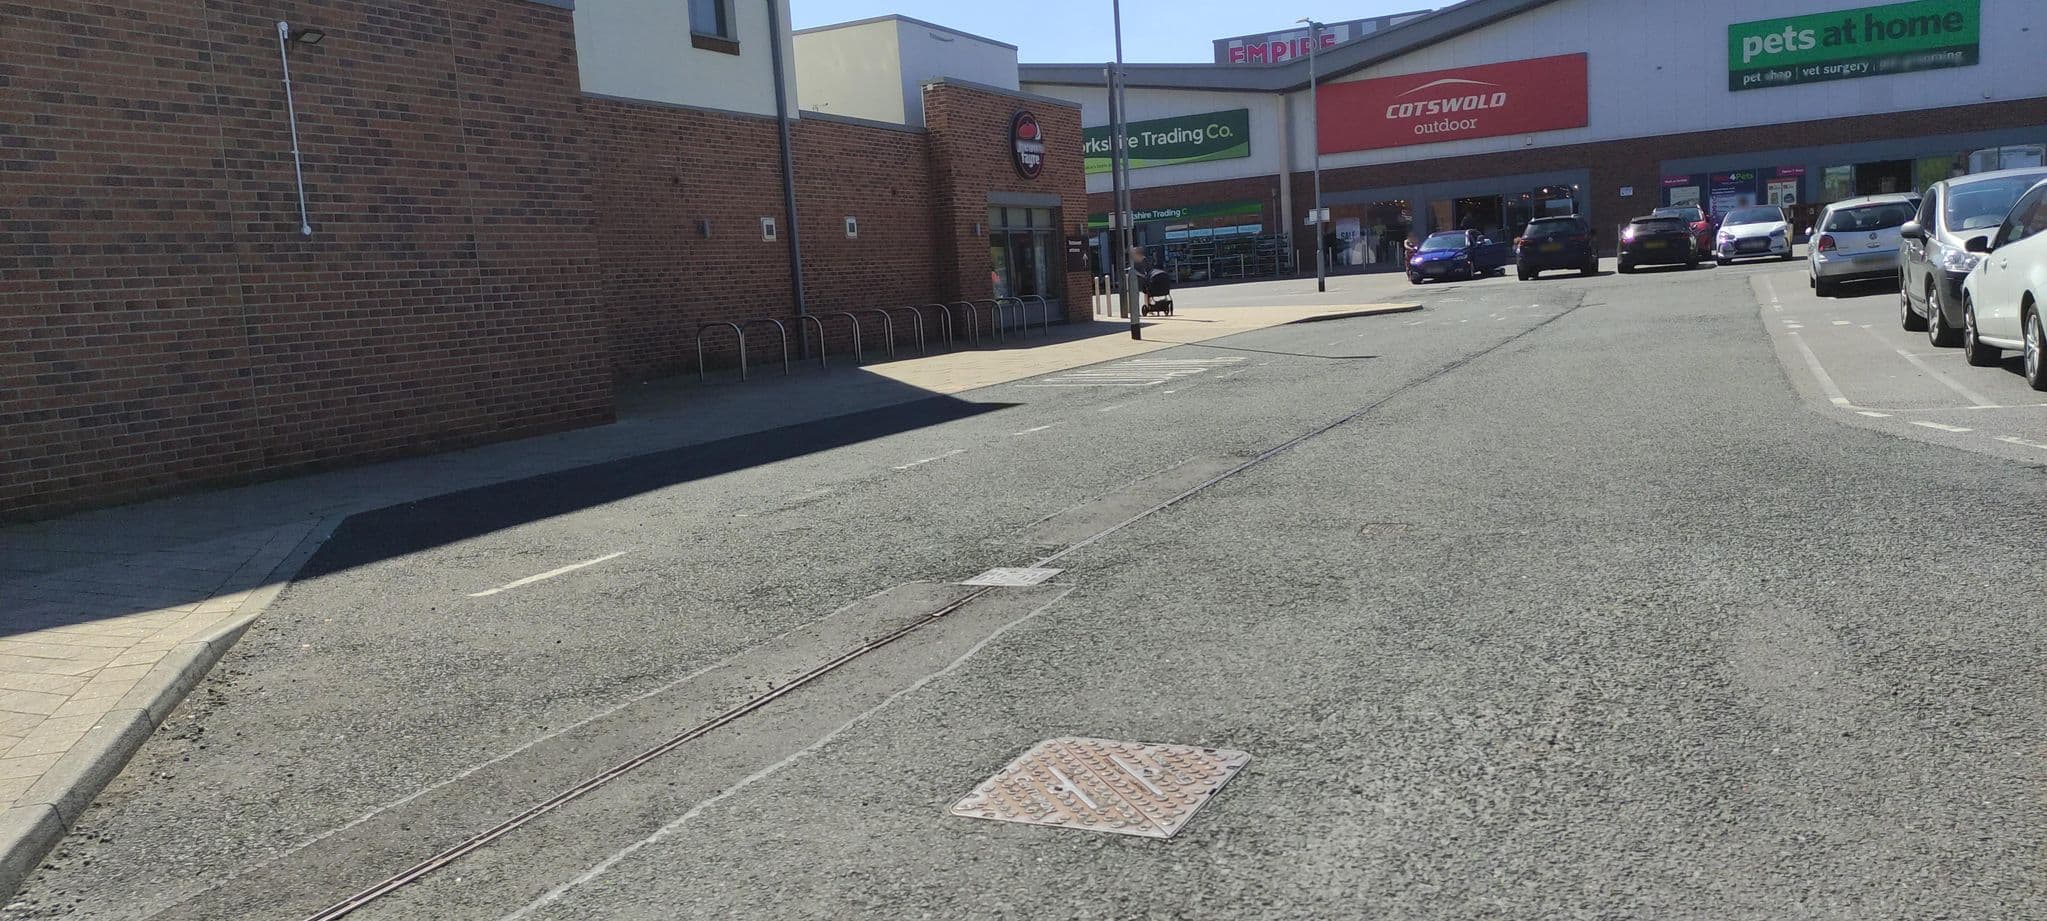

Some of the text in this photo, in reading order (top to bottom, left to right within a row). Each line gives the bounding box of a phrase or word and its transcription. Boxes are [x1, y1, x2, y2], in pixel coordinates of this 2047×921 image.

[1743, 10, 1964, 63] pets at home
[1743, 73, 1761, 85] pet
[1802, 65, 1821, 76] vet
[1823, 62, 1869, 76] surgery
[1386, 92, 1506, 119] COTSWOLD
[1141, 128, 1203, 144] Trading
[1206, 124, 1233, 139] Co.
[1414, 118, 1478, 134] outdoor
[1152, 209, 1181, 218] Trading
